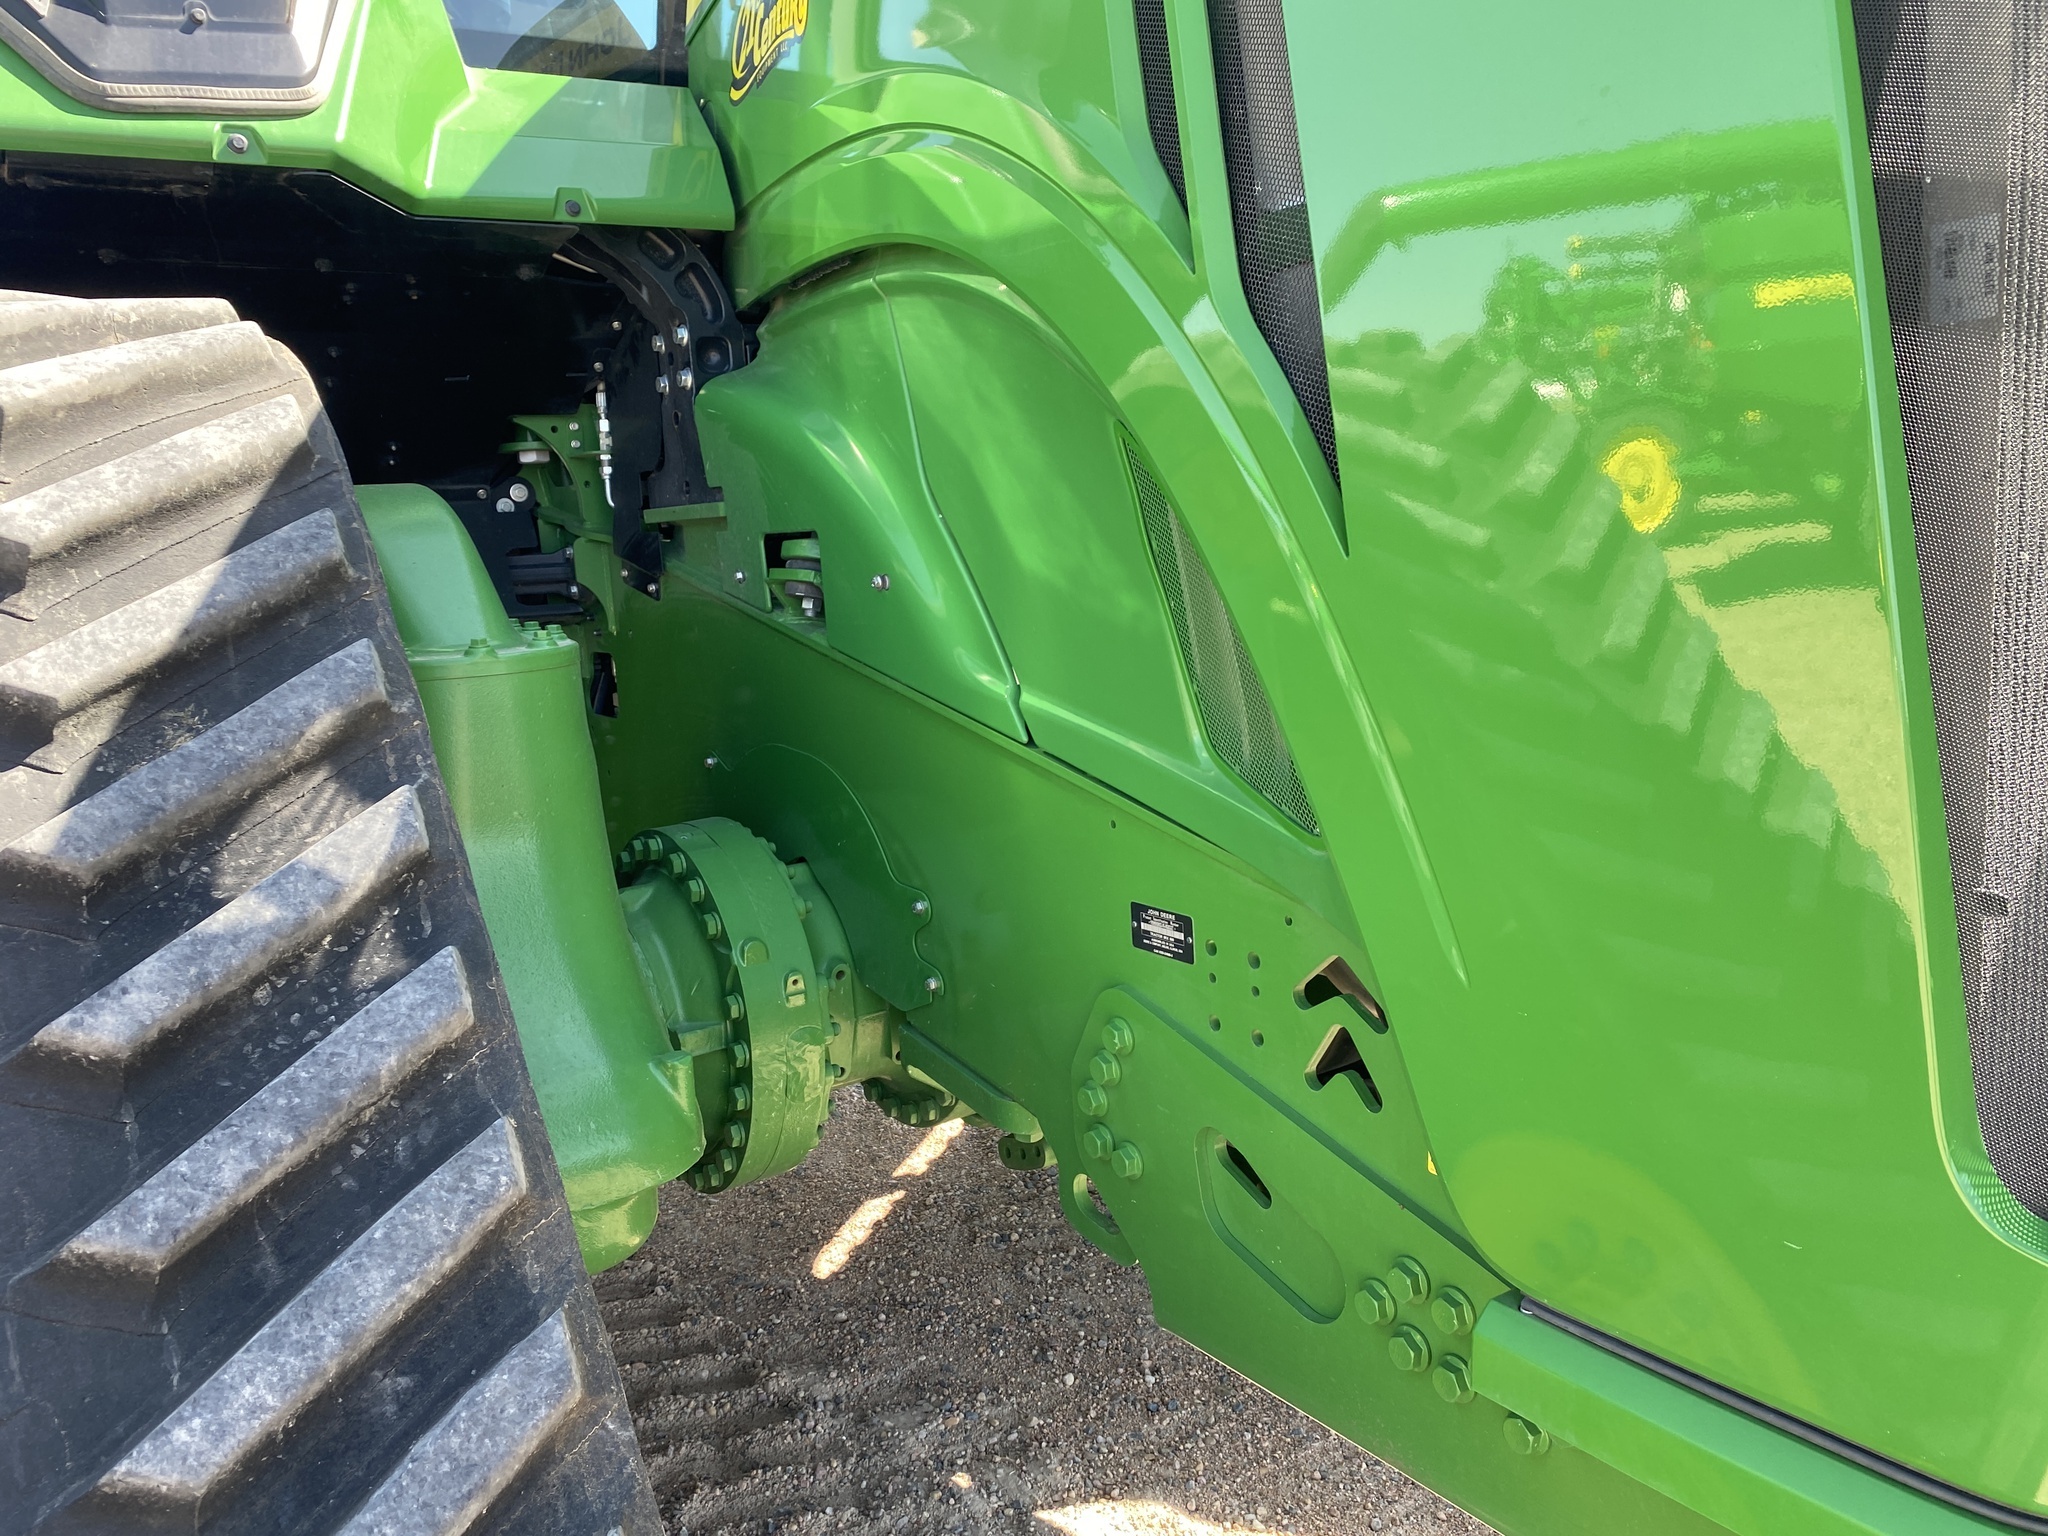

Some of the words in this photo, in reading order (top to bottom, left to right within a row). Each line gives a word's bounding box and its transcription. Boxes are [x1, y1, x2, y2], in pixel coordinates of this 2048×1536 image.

[780, 40, 788, 53] LLC
[1147, 909, 1160, 917] JOHN
[1160, 912, 1176, 921] DEERE
